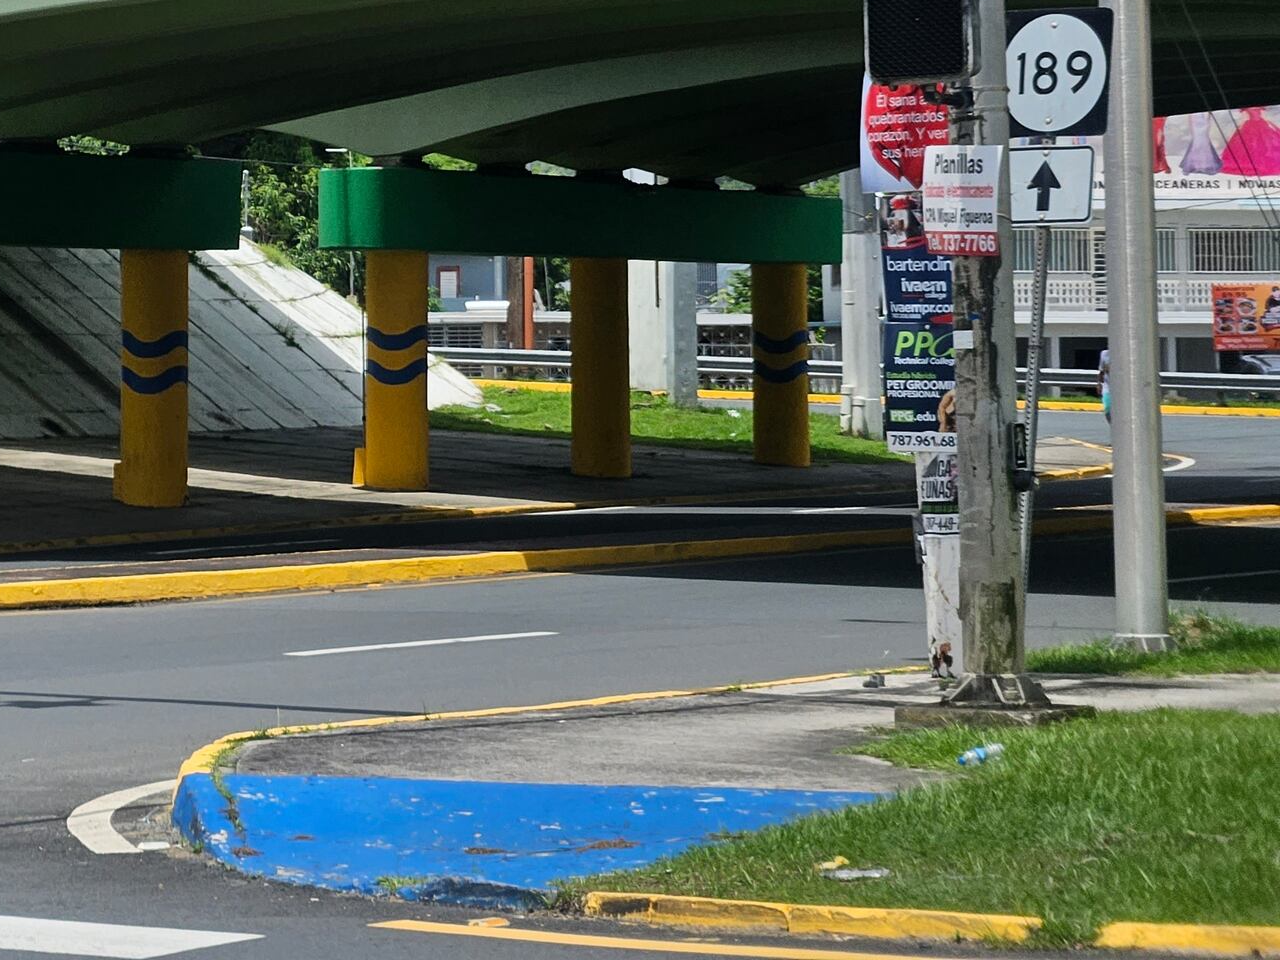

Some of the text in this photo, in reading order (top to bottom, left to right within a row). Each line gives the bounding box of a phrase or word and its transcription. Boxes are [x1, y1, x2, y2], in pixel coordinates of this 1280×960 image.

[1017, 50, 1093, 95] 189
[876, 92, 887, 107] Él
[889, 96, 916, 107] sana
[868, 111, 945, 127] quebrantados
[916, 127, 926, 140] Y
[882, 145, 925, 159] sus her
[934, 153, 983, 174] Planillas
[1155, 178, 1220, 189] CEAÑERAS
[937, 207, 958, 228] Miguel
[960, 207, 993, 228] Figueroa
[943, 234, 996, 252] 737-7766
[886, 255, 952, 271] bartendin
[889, 301, 955, 315] ivaempr.co
[893, 356, 955, 366] Technical Colleg
[887, 380, 906, 389] PET
[887, 390, 941, 398] PROFESIONAL
[890, 434, 956, 448] 787.961.68
